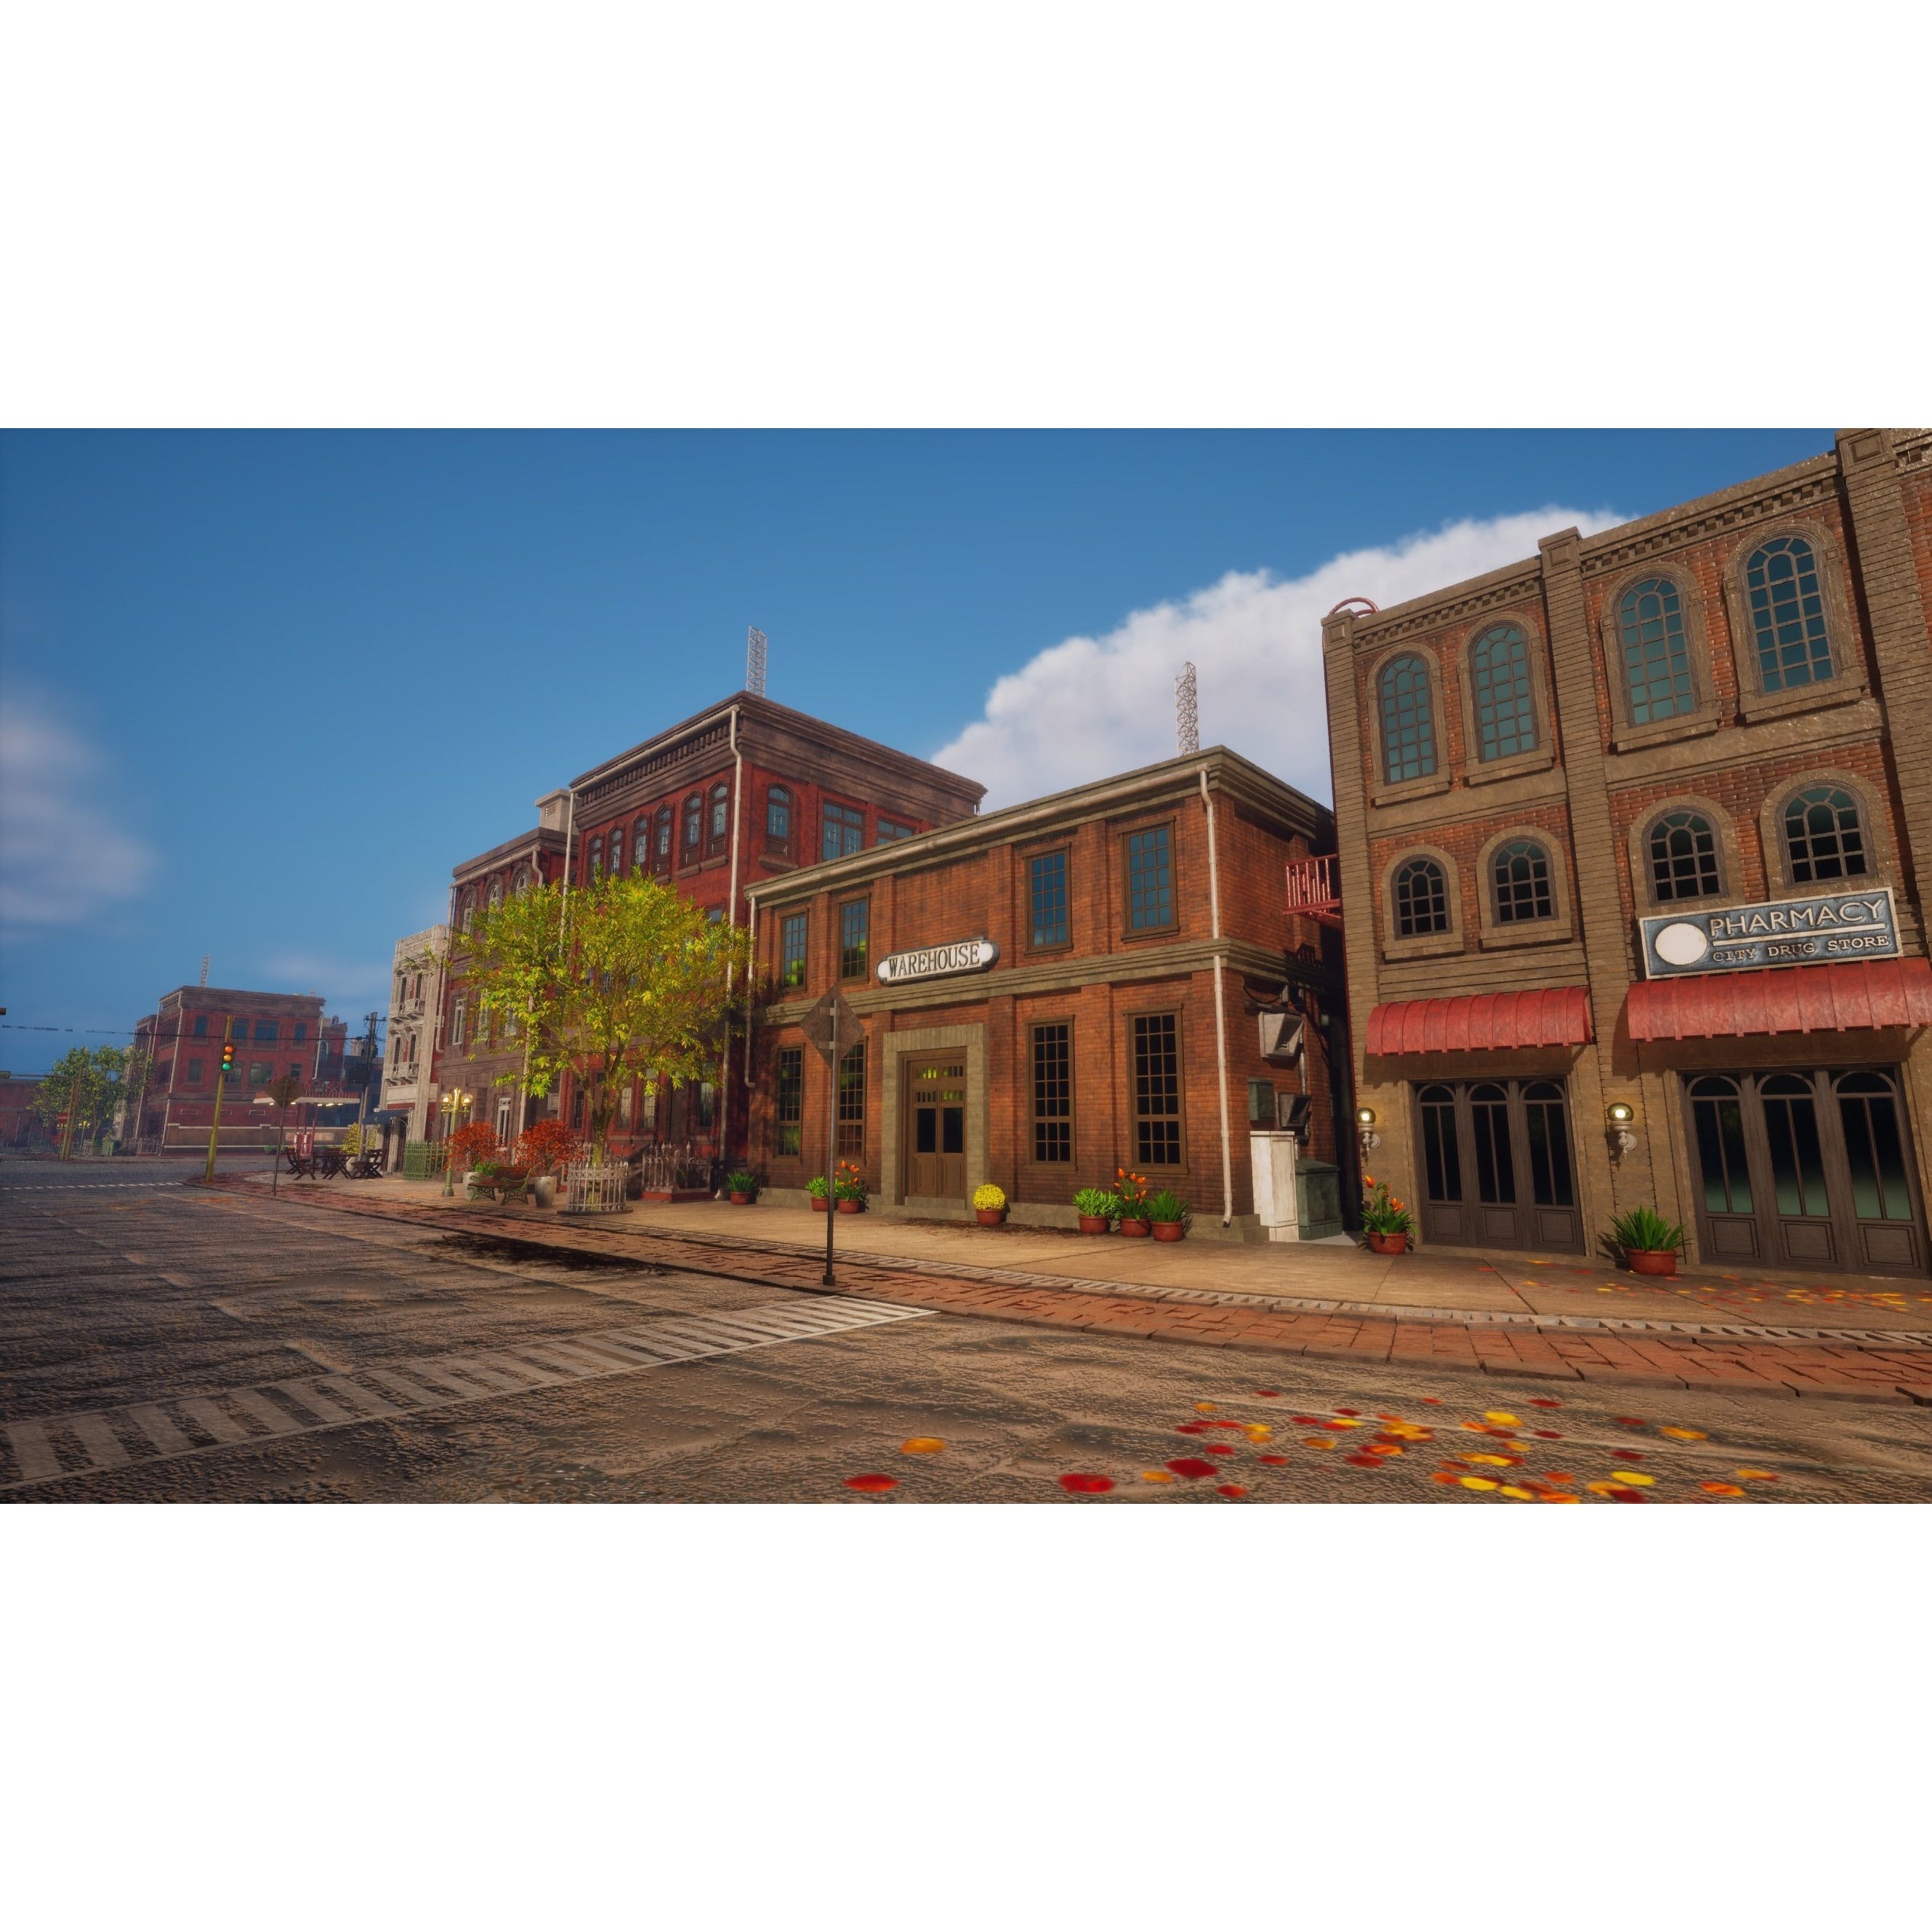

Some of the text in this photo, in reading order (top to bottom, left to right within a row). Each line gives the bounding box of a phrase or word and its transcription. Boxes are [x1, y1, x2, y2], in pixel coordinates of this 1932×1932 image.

[1710, 899, 1883, 936] PHARMACY
[889, 944, 980, 978] WAREHOUSE
[1712, 935, 1889, 962] CITY DRUG STORE
